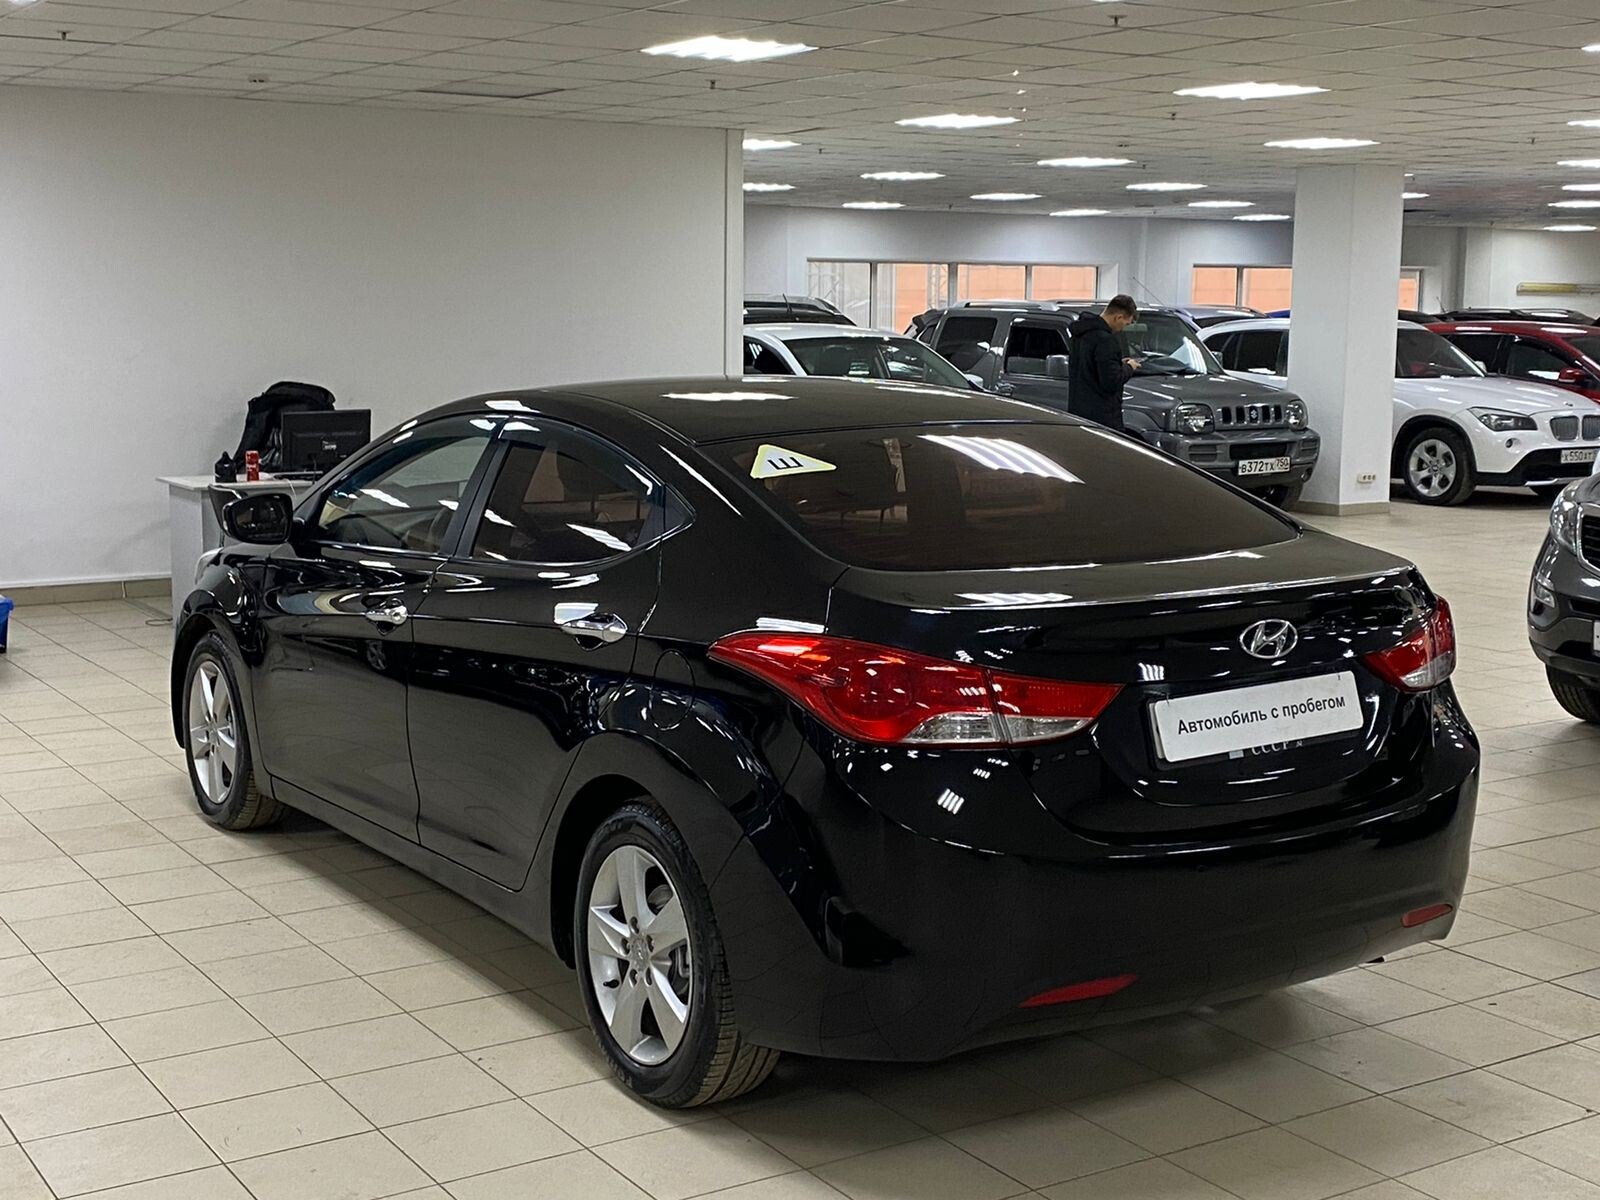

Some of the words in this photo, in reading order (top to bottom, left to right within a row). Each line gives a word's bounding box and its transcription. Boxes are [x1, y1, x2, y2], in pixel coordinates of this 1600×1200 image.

[1178, 710, 1267, 735] Автомобиль
[1271, 705, 1280, 719] с
[1283, 696, 1345, 719] пробегом
